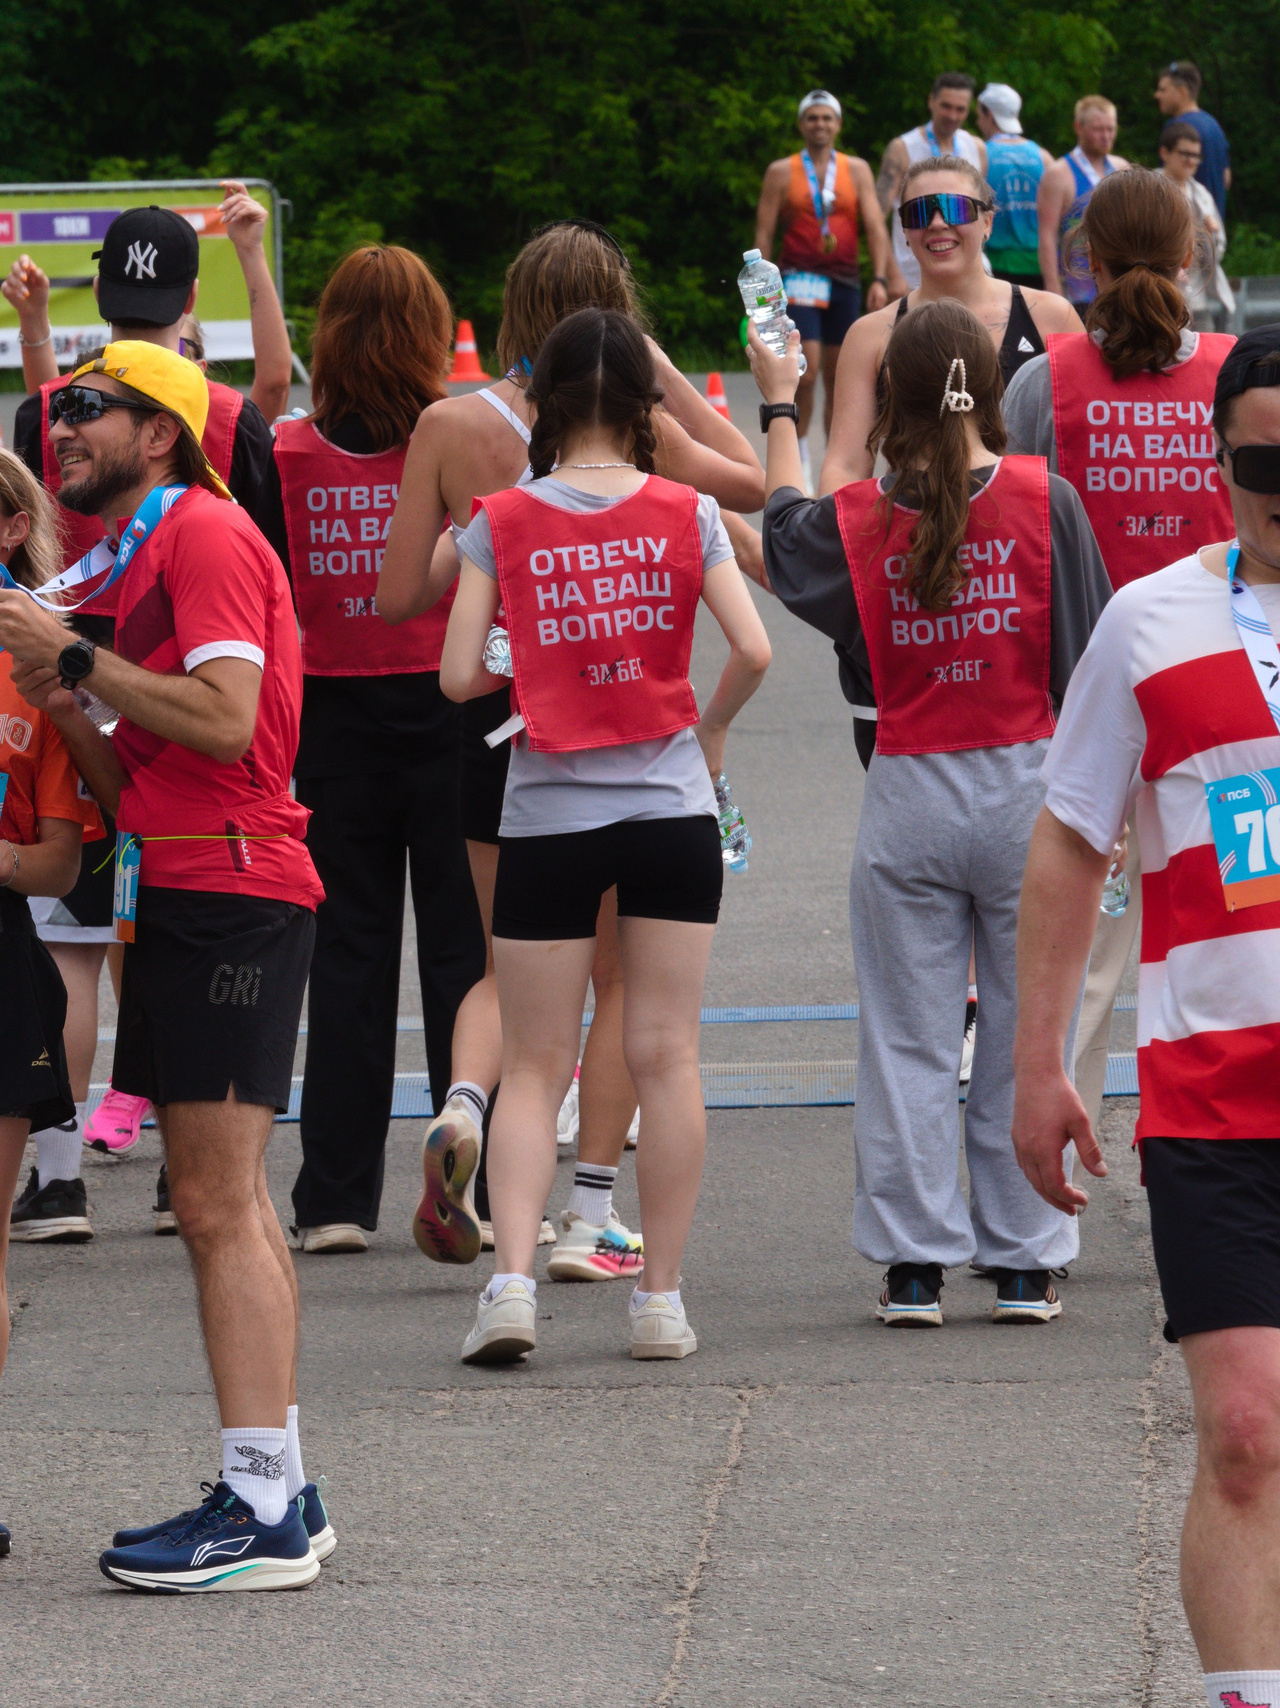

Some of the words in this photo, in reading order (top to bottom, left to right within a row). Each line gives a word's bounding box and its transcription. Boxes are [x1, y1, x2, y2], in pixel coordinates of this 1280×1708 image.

[125, 240, 158, 279] NY
[1086, 400, 1214, 426] ОТВЕЧУ
[1089, 433, 1136, 459] НА
[1144, 433, 1217, 459] ВАШ
[1086, 466, 1218, 493] ВОПРОС
[307, 484, 399, 512] ОТВЕ
[310, 519, 352, 544] НА
[120, 536, 135, 566] ПСБ
[529, 537, 668, 576] ОТВЕЧУ
[884, 539, 1016, 580] ОЕЧУ
[536, 580, 587, 611] НА
[593, 572, 672, 605] ВАШ
[537, 605, 675, 646] ВОПРОС
[891, 607, 1021, 646] ВОПРОС
[1227, 787, 1251, 801] ПСБ
